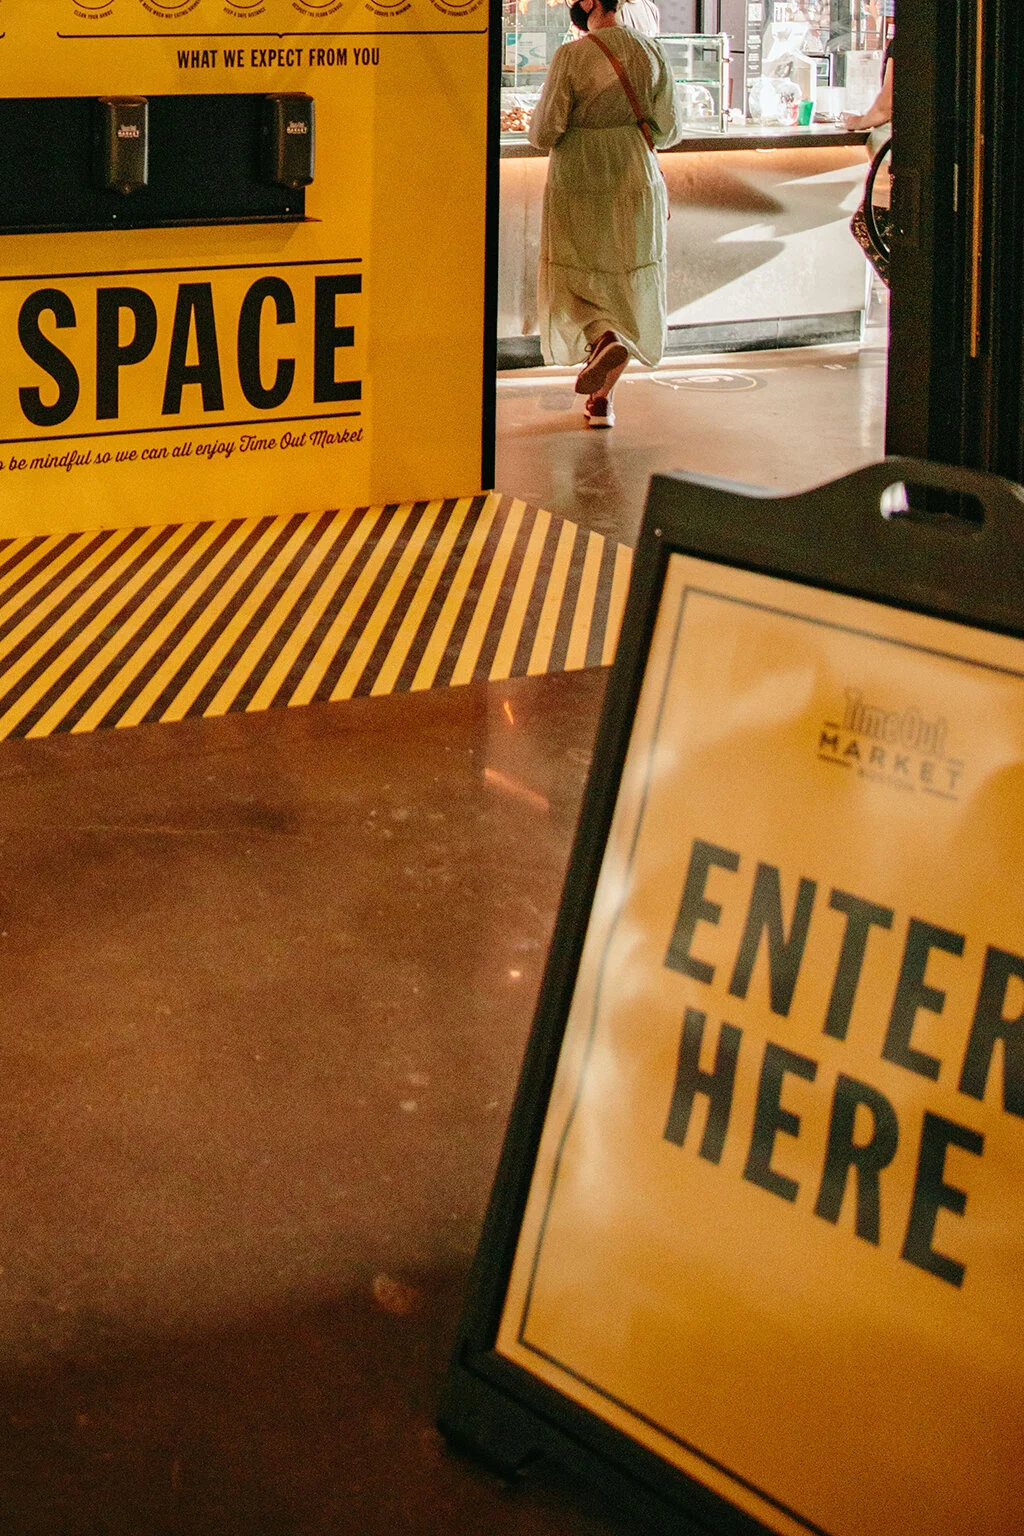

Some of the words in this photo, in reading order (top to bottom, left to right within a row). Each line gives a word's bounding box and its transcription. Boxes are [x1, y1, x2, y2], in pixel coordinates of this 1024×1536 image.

[177, 50, 218, 69] WHAT
[224, 50, 245, 68] WE
[250, 49, 303, 67] EXPECT
[308, 48, 348, 66] FROM
[353, 48, 380, 65] YOU
[18, 273, 362, 427] SPACE
[8, 456, 27, 471] be
[30, 450, 92, 472] mindful
[94, 450, 111, 465] so
[114, 448, 138, 462] we
[141, 446, 169, 460] can
[172, 442, 193, 458] all
[195, 441, 236, 460] enjoy
[240, 434, 277, 452] Time
[280, 431, 307, 448] Out
[310, 428, 364, 448] Market
[818, 730, 964, 790] MARKET
[662, 836, 1024, 1119] ENTER
[662, 1005, 986, 1290] HERE
